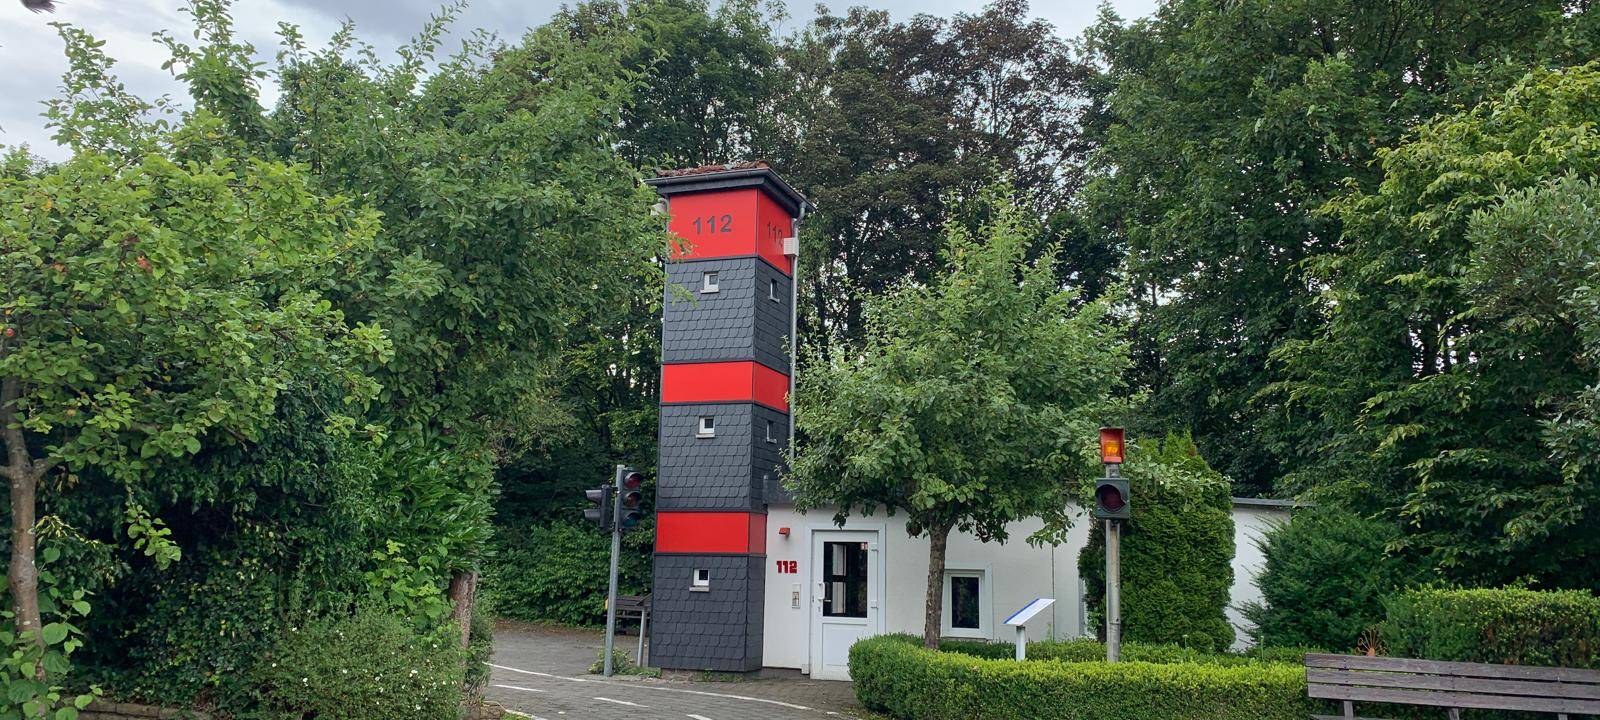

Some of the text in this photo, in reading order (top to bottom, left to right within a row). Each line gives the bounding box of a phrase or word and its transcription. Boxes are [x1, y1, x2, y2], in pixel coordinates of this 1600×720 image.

[692, 214, 733, 235] 112
[767, 221, 784, 248] 112
[776, 560, 798, 574] 112
